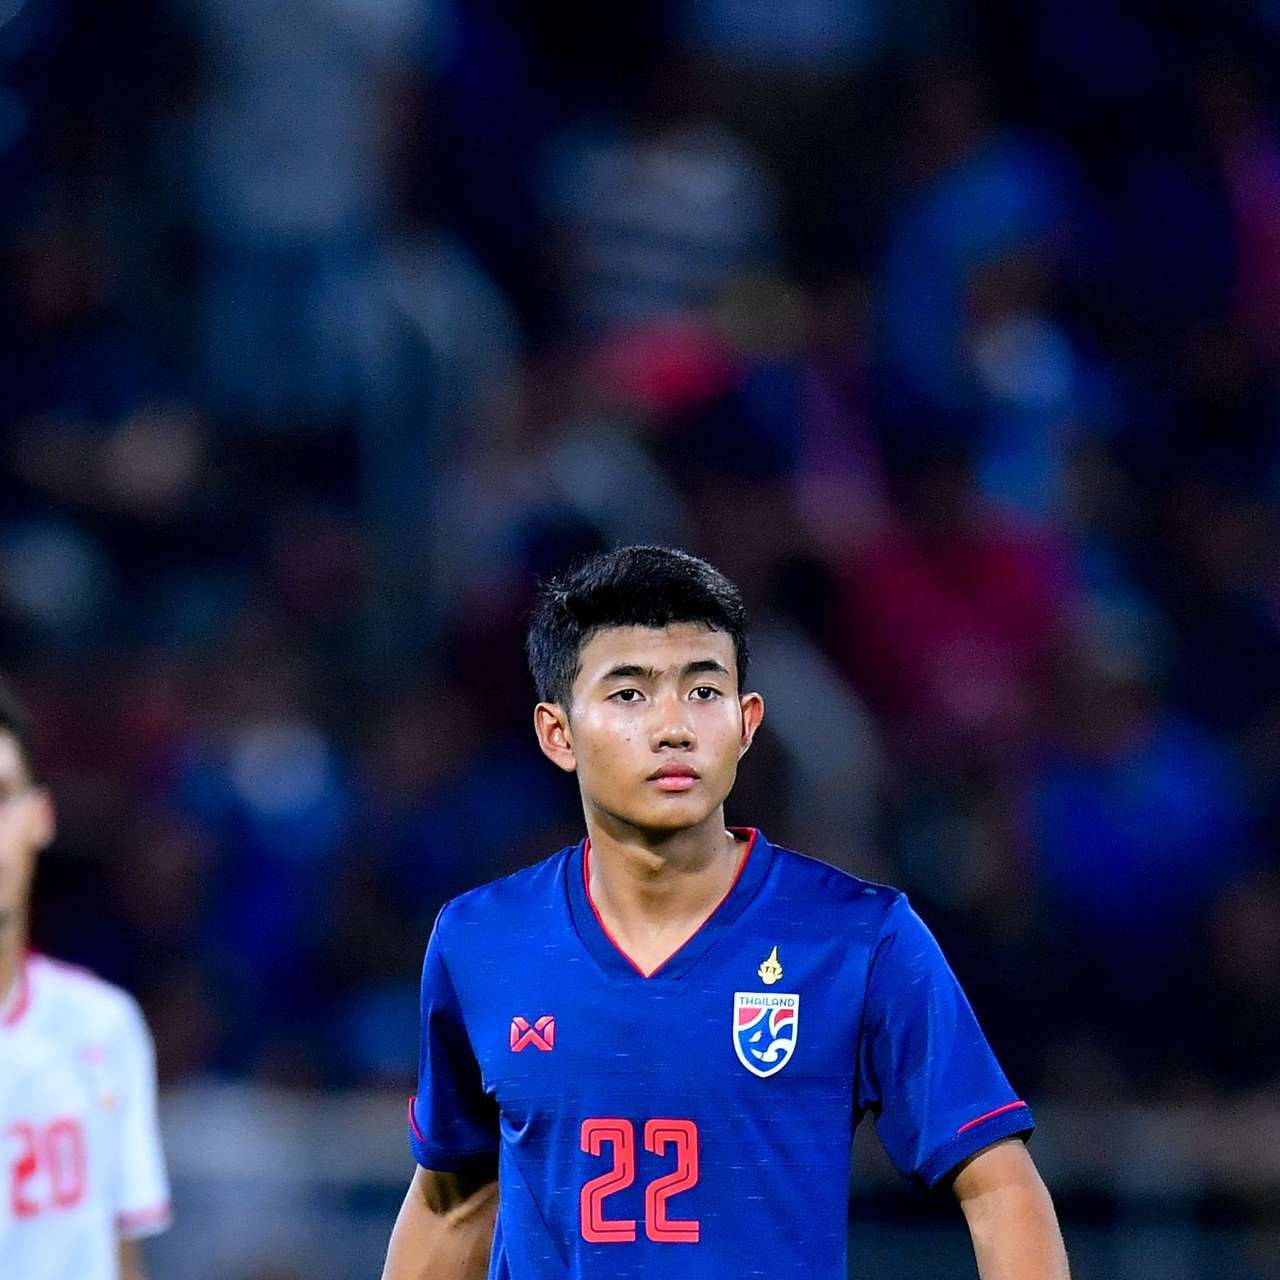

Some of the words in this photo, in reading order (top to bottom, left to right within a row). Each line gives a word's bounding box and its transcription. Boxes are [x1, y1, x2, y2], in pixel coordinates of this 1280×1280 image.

[739, 996, 795, 1007] THAILAND
[5, 1117, 85, 1221] 20
[580, 1118, 700, 1243] 22
